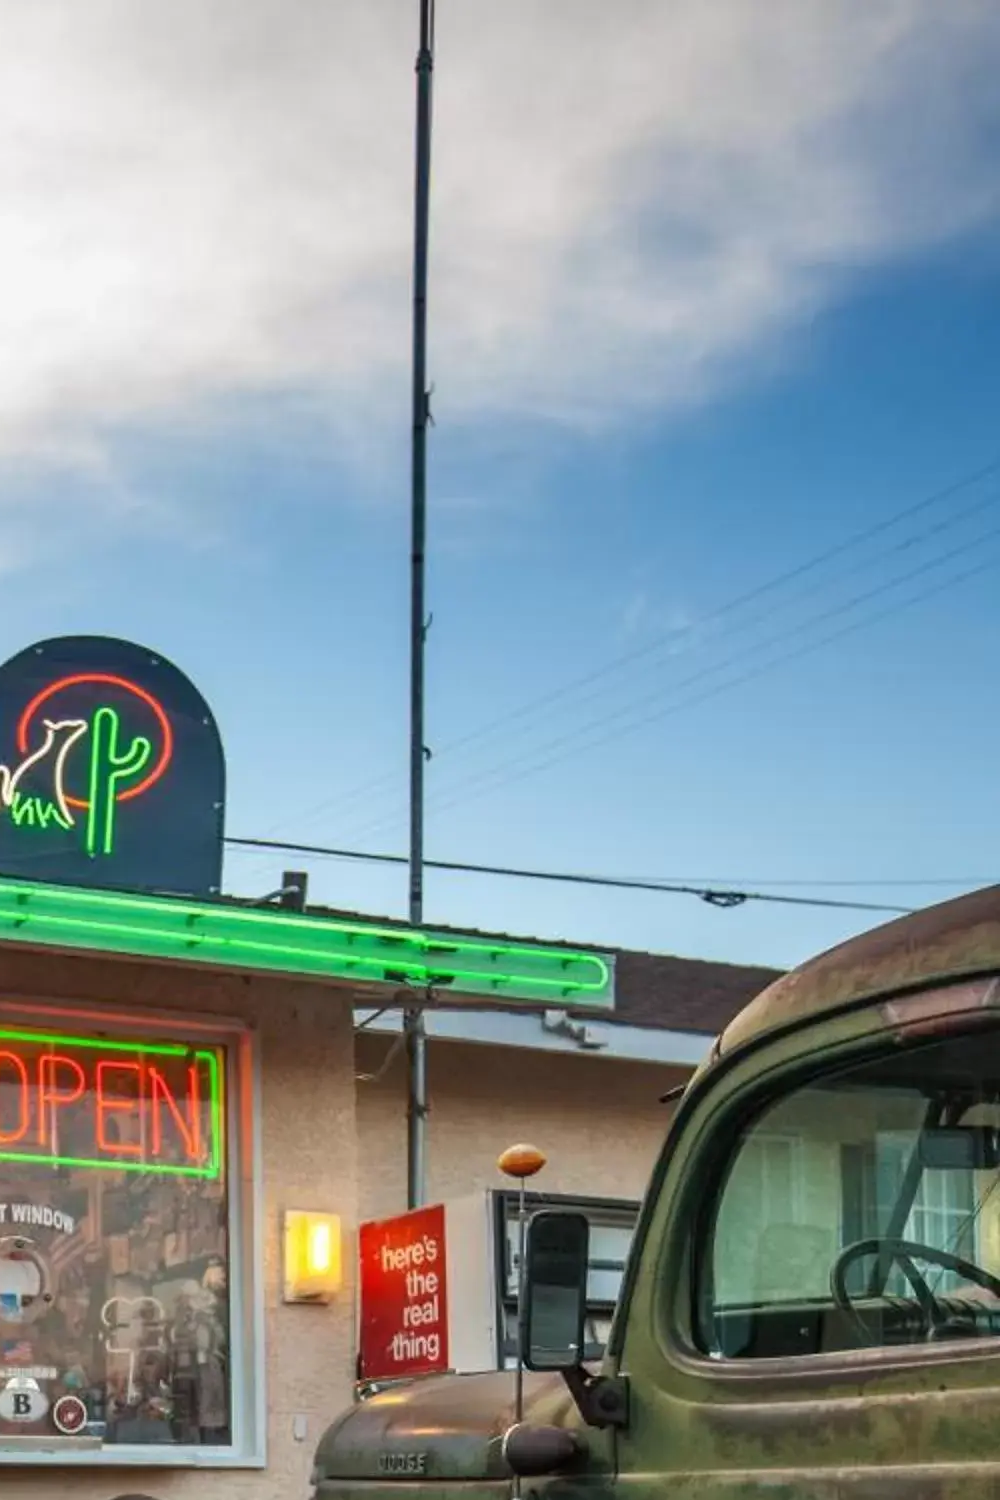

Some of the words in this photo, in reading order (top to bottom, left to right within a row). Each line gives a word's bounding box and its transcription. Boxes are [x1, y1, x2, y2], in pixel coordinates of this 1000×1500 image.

[11, 1203, 75, 1235] WINDOW
[381, 1234, 438, 1272] here's
[405, 1270, 438, 1297] the
[403, 1295, 439, 1328] real
[392, 1331, 440, 1362] thing
[13, 1393, 31, 1415] B
